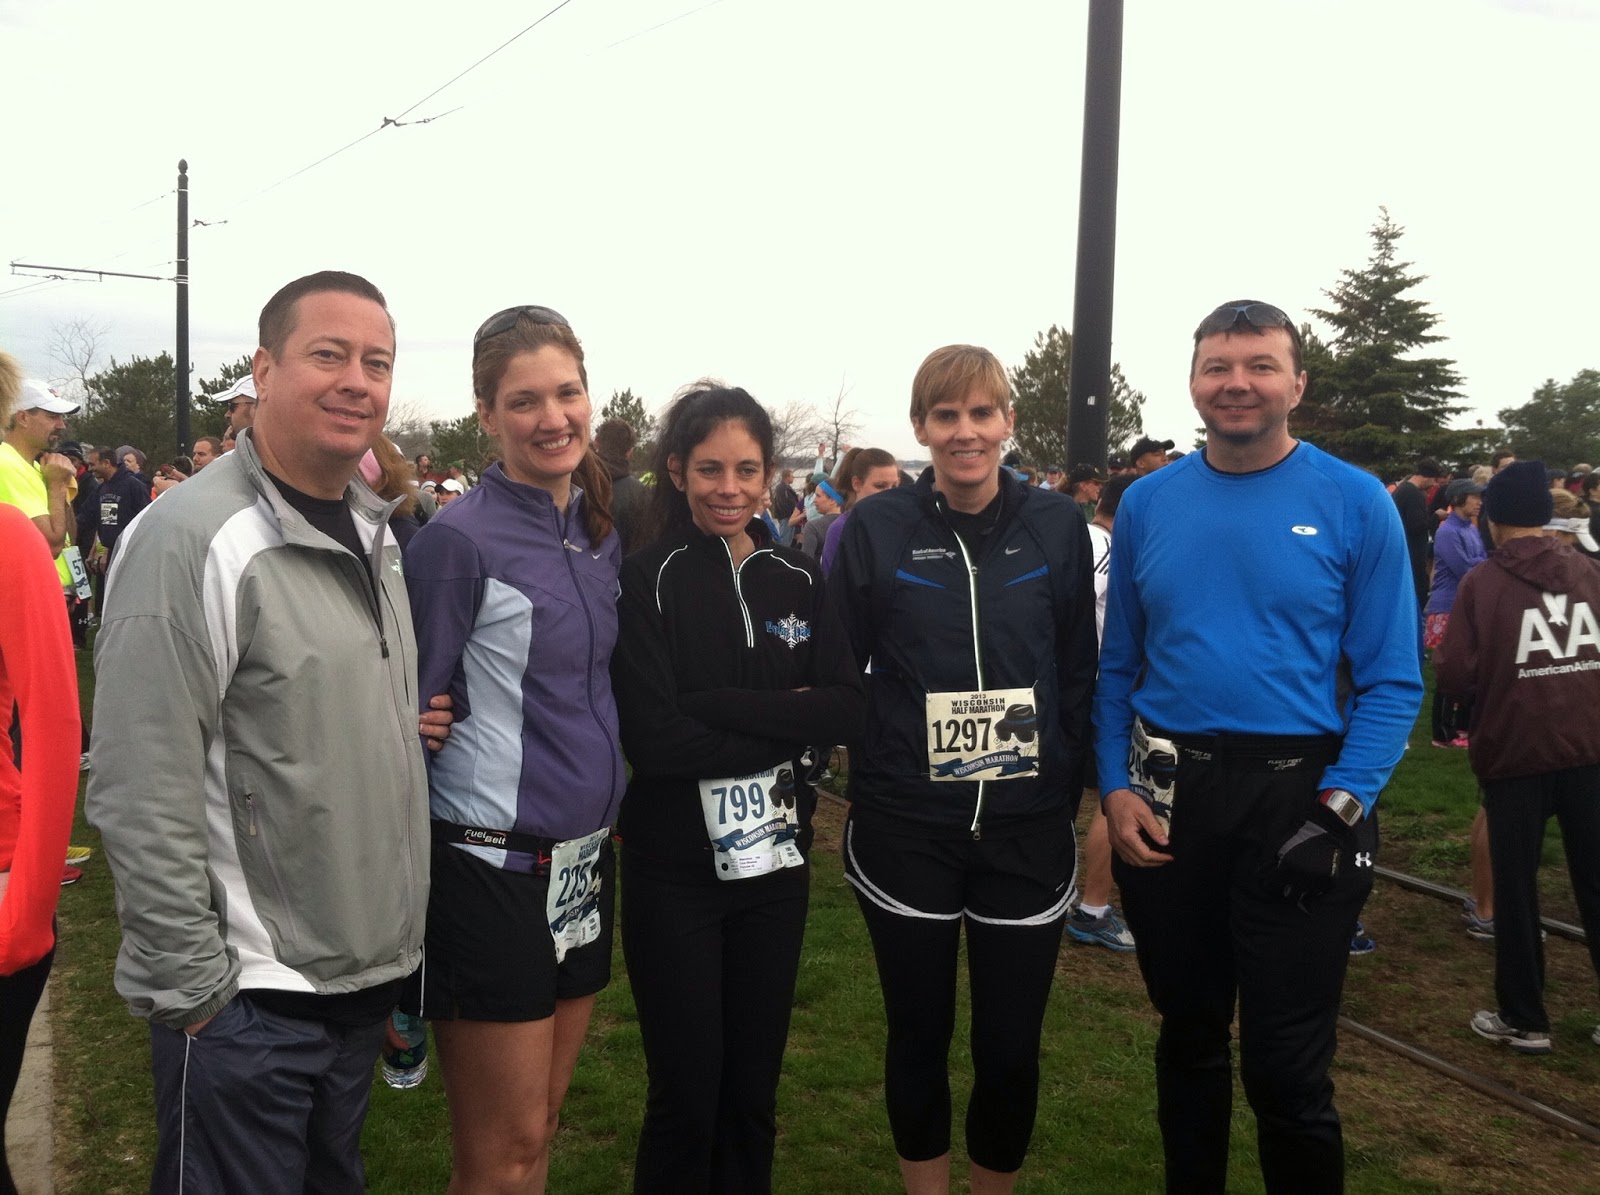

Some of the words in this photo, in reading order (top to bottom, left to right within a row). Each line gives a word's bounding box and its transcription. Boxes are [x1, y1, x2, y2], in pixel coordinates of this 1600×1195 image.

[951, 698, 1006, 707] WISCONSIN
[951, 707, 969, 715] HALF
[969, 704, 1006, 714] MARATHON
[932, 717, 992, 754] 1297
[953, 758, 986, 776] WISCONSIN
[984, 754, 1018, 764] MARATHON
[711, 782, 766, 825] 799
[734, 827, 766, 848] WISCONSIN
